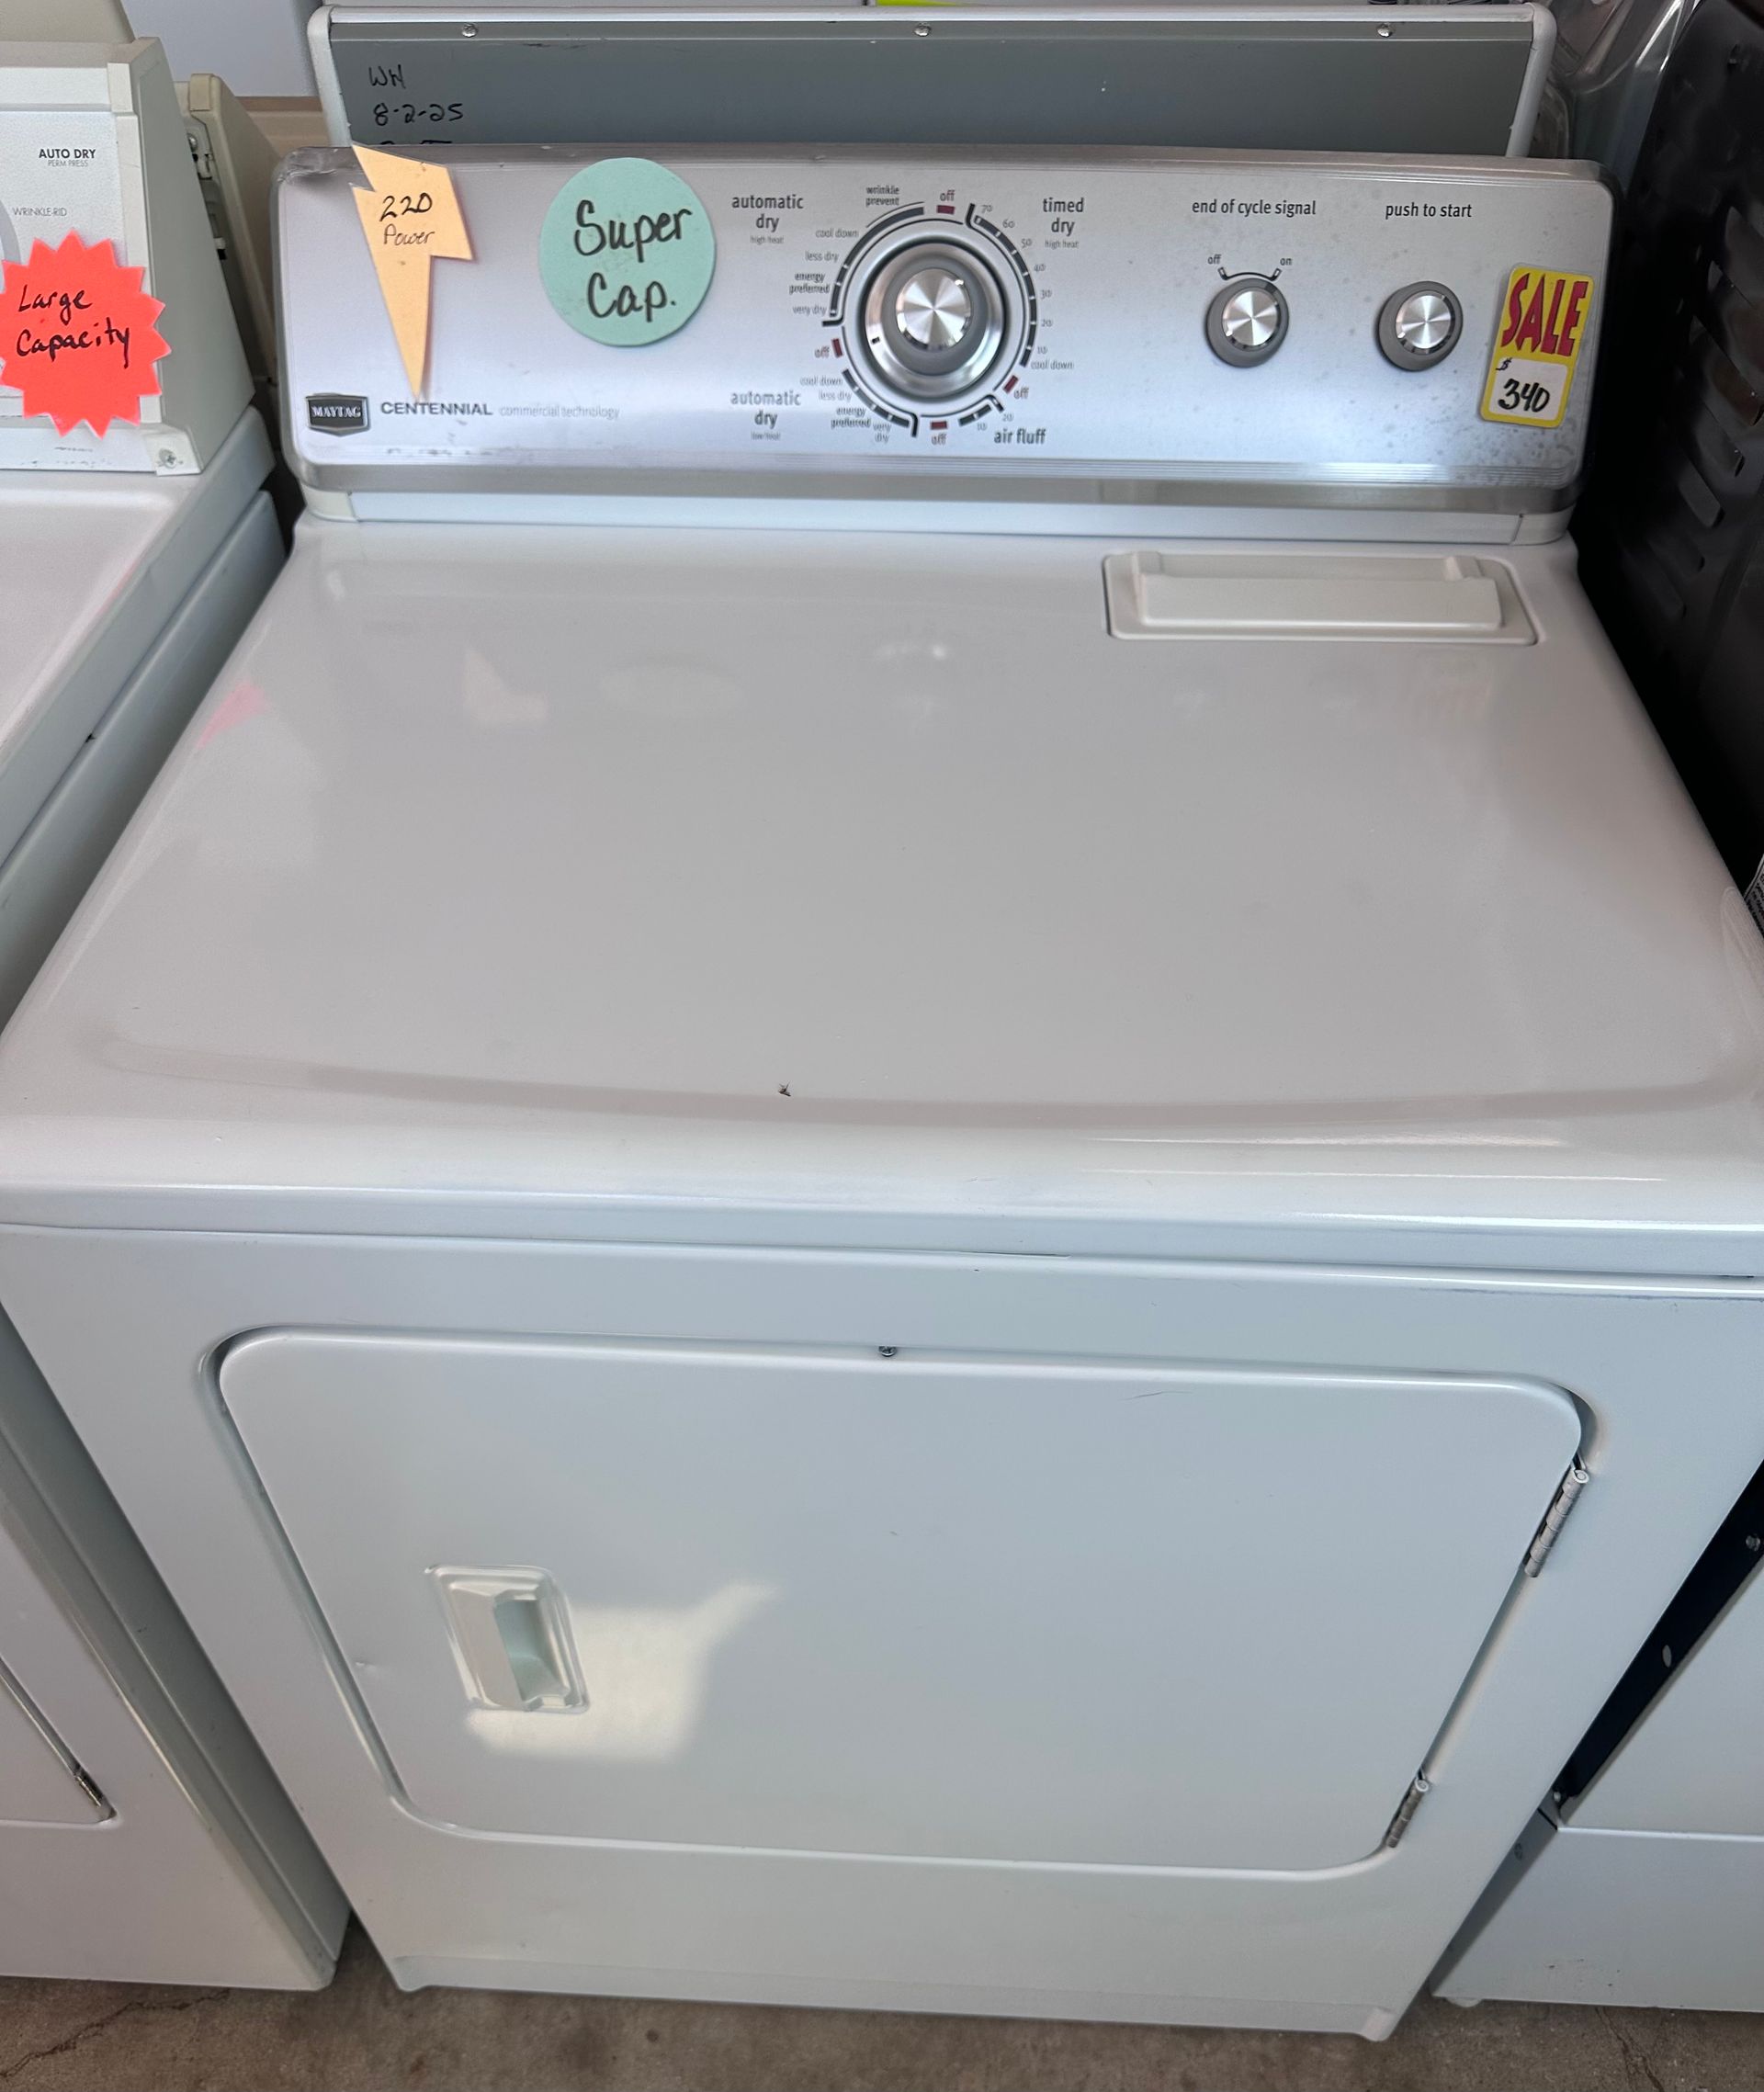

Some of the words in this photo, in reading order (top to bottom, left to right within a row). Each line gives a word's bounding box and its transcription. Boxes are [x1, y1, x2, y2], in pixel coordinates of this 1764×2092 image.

[373, 103, 464, 126] 8-2-25
[39, 148, 71, 159] AUTO
[74, 149, 96, 159] DRY
[866, 186, 899, 195] wrinkle
[939, 190, 956, 202] off
[379, 192, 433, 222] 220
[731, 194, 805, 209] automatic
[865, 197, 899, 207] prevent
[1042, 197, 1084, 213] timed
[13, 207, 68, 217] WRINKLE-RID
[981, 204, 993, 213] 70
[1192, 199, 1217, 214] end
[1221, 199, 1236, 213] of
[1238, 201, 1272, 217] cycle
[1274, 200, 1317, 218] signal
[1385, 202, 1419, 220] push
[1423, 203, 1436, 217] to
[1440, 203, 1473, 218] start
[755, 213, 780, 232] dry
[1002, 221, 1015, 229] 60
[1051, 218, 1075, 236] dry
[383, 223, 435, 246] Power
[573, 199, 694, 264] Super
[815, 229, 833, 238] cool
[834, 229, 859, 238] down
[750, 235, 766, 245] high
[768, 235, 785, 244] heat
[1021, 239, 1033, 248] 50
[1045, 239, 1062, 251] high
[1063, 239, 1080, 249] heat
[805, 251, 822, 261] less
[824, 251, 839, 263] dry
[1207, 254, 1221, 265] off
[1280, 257, 1293, 266] on
[1034, 264, 1046, 273] 40
[794, 273, 826, 284] energy
[789, 283, 831, 295] preferred
[1040, 289, 1052, 299] 30
[587, 272, 676, 322] Cap.
[18, 285, 93, 325] Large
[792, 307, 810, 316] very
[812, 304, 827, 316] dry
[1500, 272, 1589, 356] SALE
[1041, 319, 1053, 327] 20
[17, 317, 130, 369] Capacity
[814, 345, 831, 358] off
[1031, 359, 1049, 370] cool
[1050, 359, 1074, 370] down
[1496, 356, 1512, 371] $
[799, 376, 818, 386] cool
[819, 376, 842, 386] down
[730, 390, 802, 406] automatic
[837, 390, 852, 402] dry
[1013, 387, 1029, 399] off
[1498, 378, 1551, 413] 340
[311, 405, 362, 419] MAYTAG
[380, 401, 493, 415] CENTENNIAL
[499, 404, 560, 417] commercial
[561, 404, 621, 421] technology
[836, 407, 867, 417] energy
[754, 410, 778, 430] dry
[831, 418, 872, 429] preferred
[873, 423, 892, 433] very
[932, 434, 947, 446] off
[993, 428, 1013, 444] air
[1016, 428, 1046, 445] fluff
